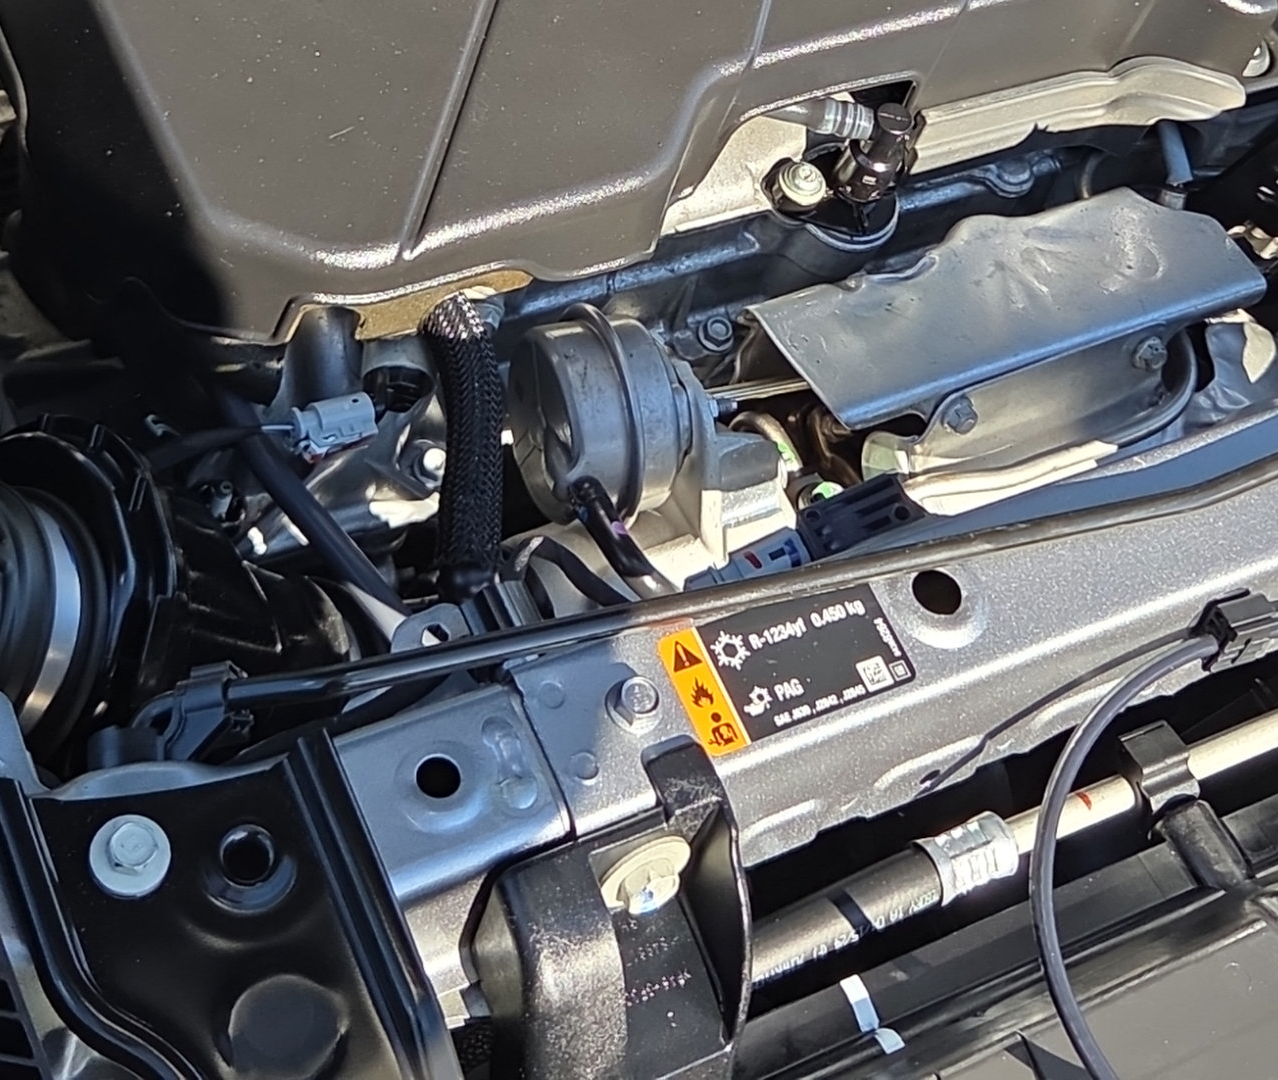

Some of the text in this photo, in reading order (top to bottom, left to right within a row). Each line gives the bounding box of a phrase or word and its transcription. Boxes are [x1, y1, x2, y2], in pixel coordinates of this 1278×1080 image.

[748, 599, 866, 650] R-1234yf 0.450 kg
[773, 678, 805, 703] PAG
[773, 713, 791, 727] SAE
